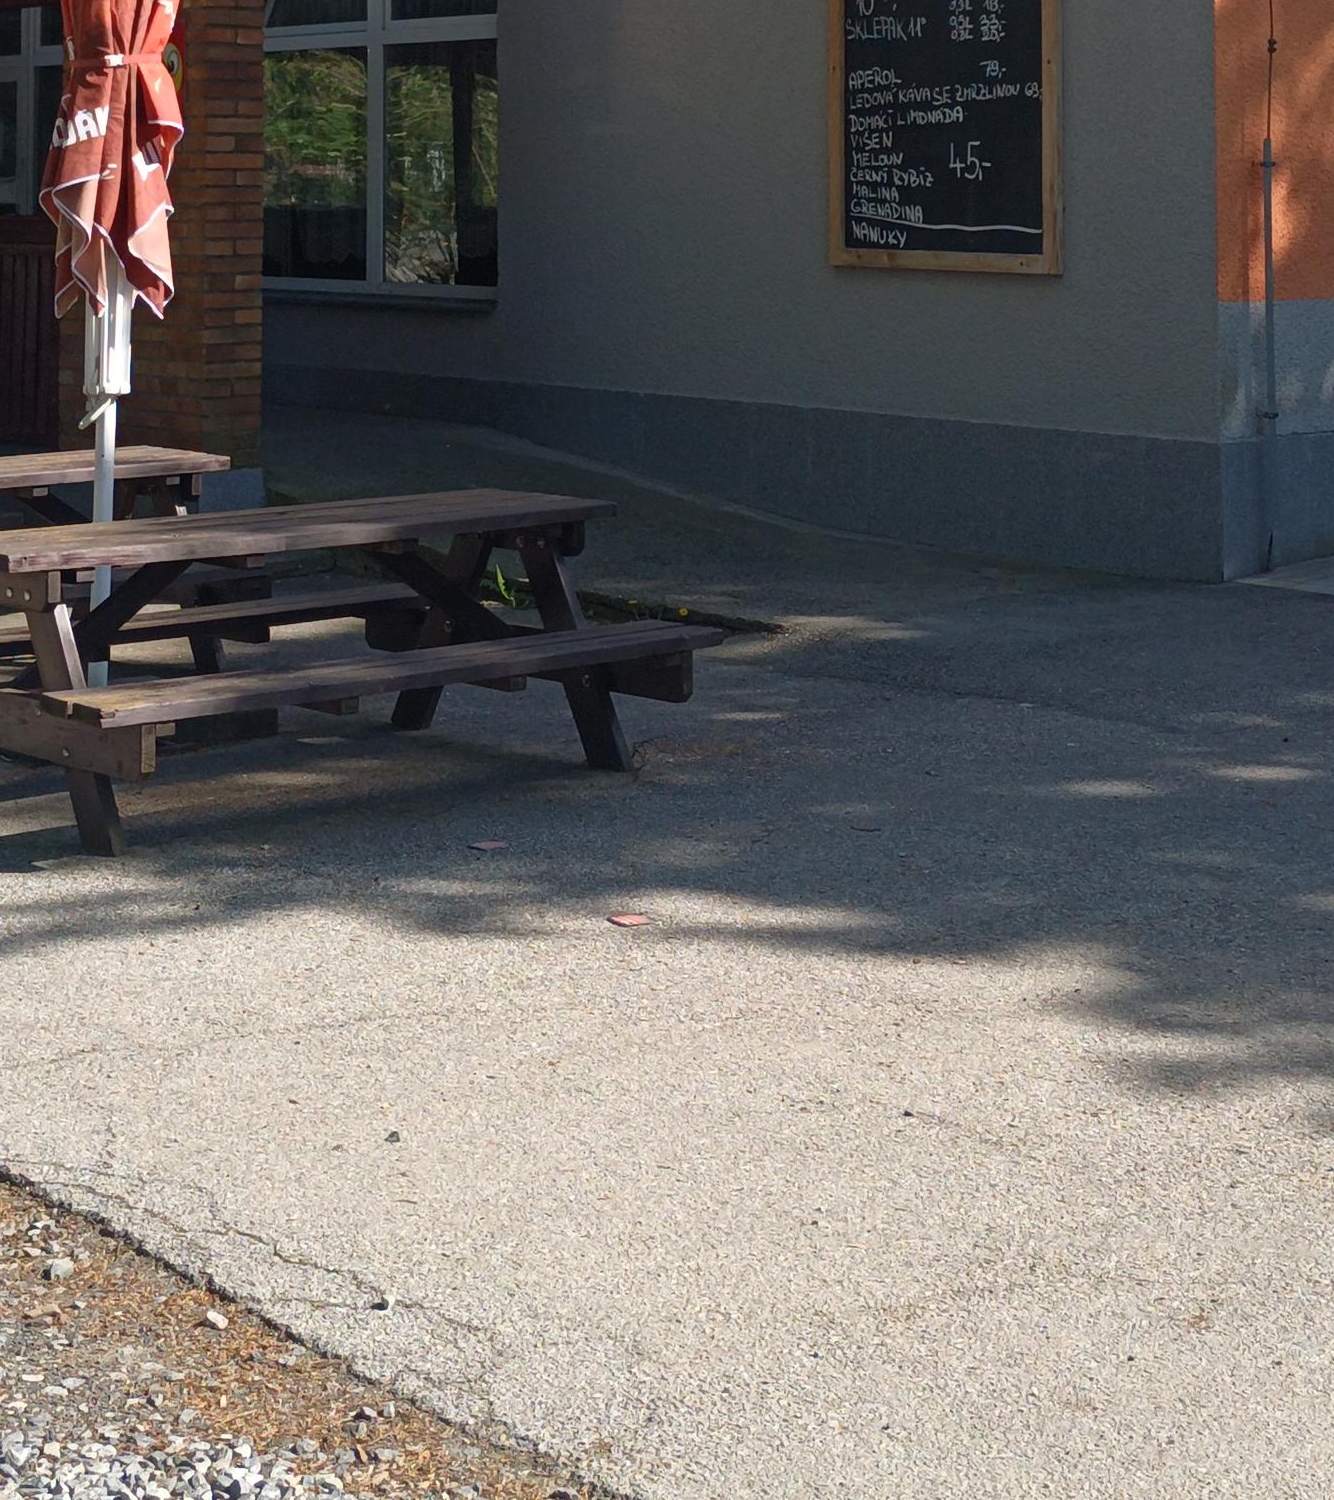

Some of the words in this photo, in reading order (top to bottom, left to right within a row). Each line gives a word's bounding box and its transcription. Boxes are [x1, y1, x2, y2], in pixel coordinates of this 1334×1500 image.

[848, 66, 902, 90] APEROL
[849, 87, 897, 109] LEDOVÁ
[898, 83, 931, 103] KÁVA
[932, 86, 952, 105] SE
[897, 106, 964, 125] LIMONÁDA
[852, 150, 904, 167] MELOUN
[948, 141, 992, 181] 45,-
[853, 183, 900, 202] MALINA
[851, 199, 924, 224] GRENADINA
[851, 220, 908, 248] NANUKY
